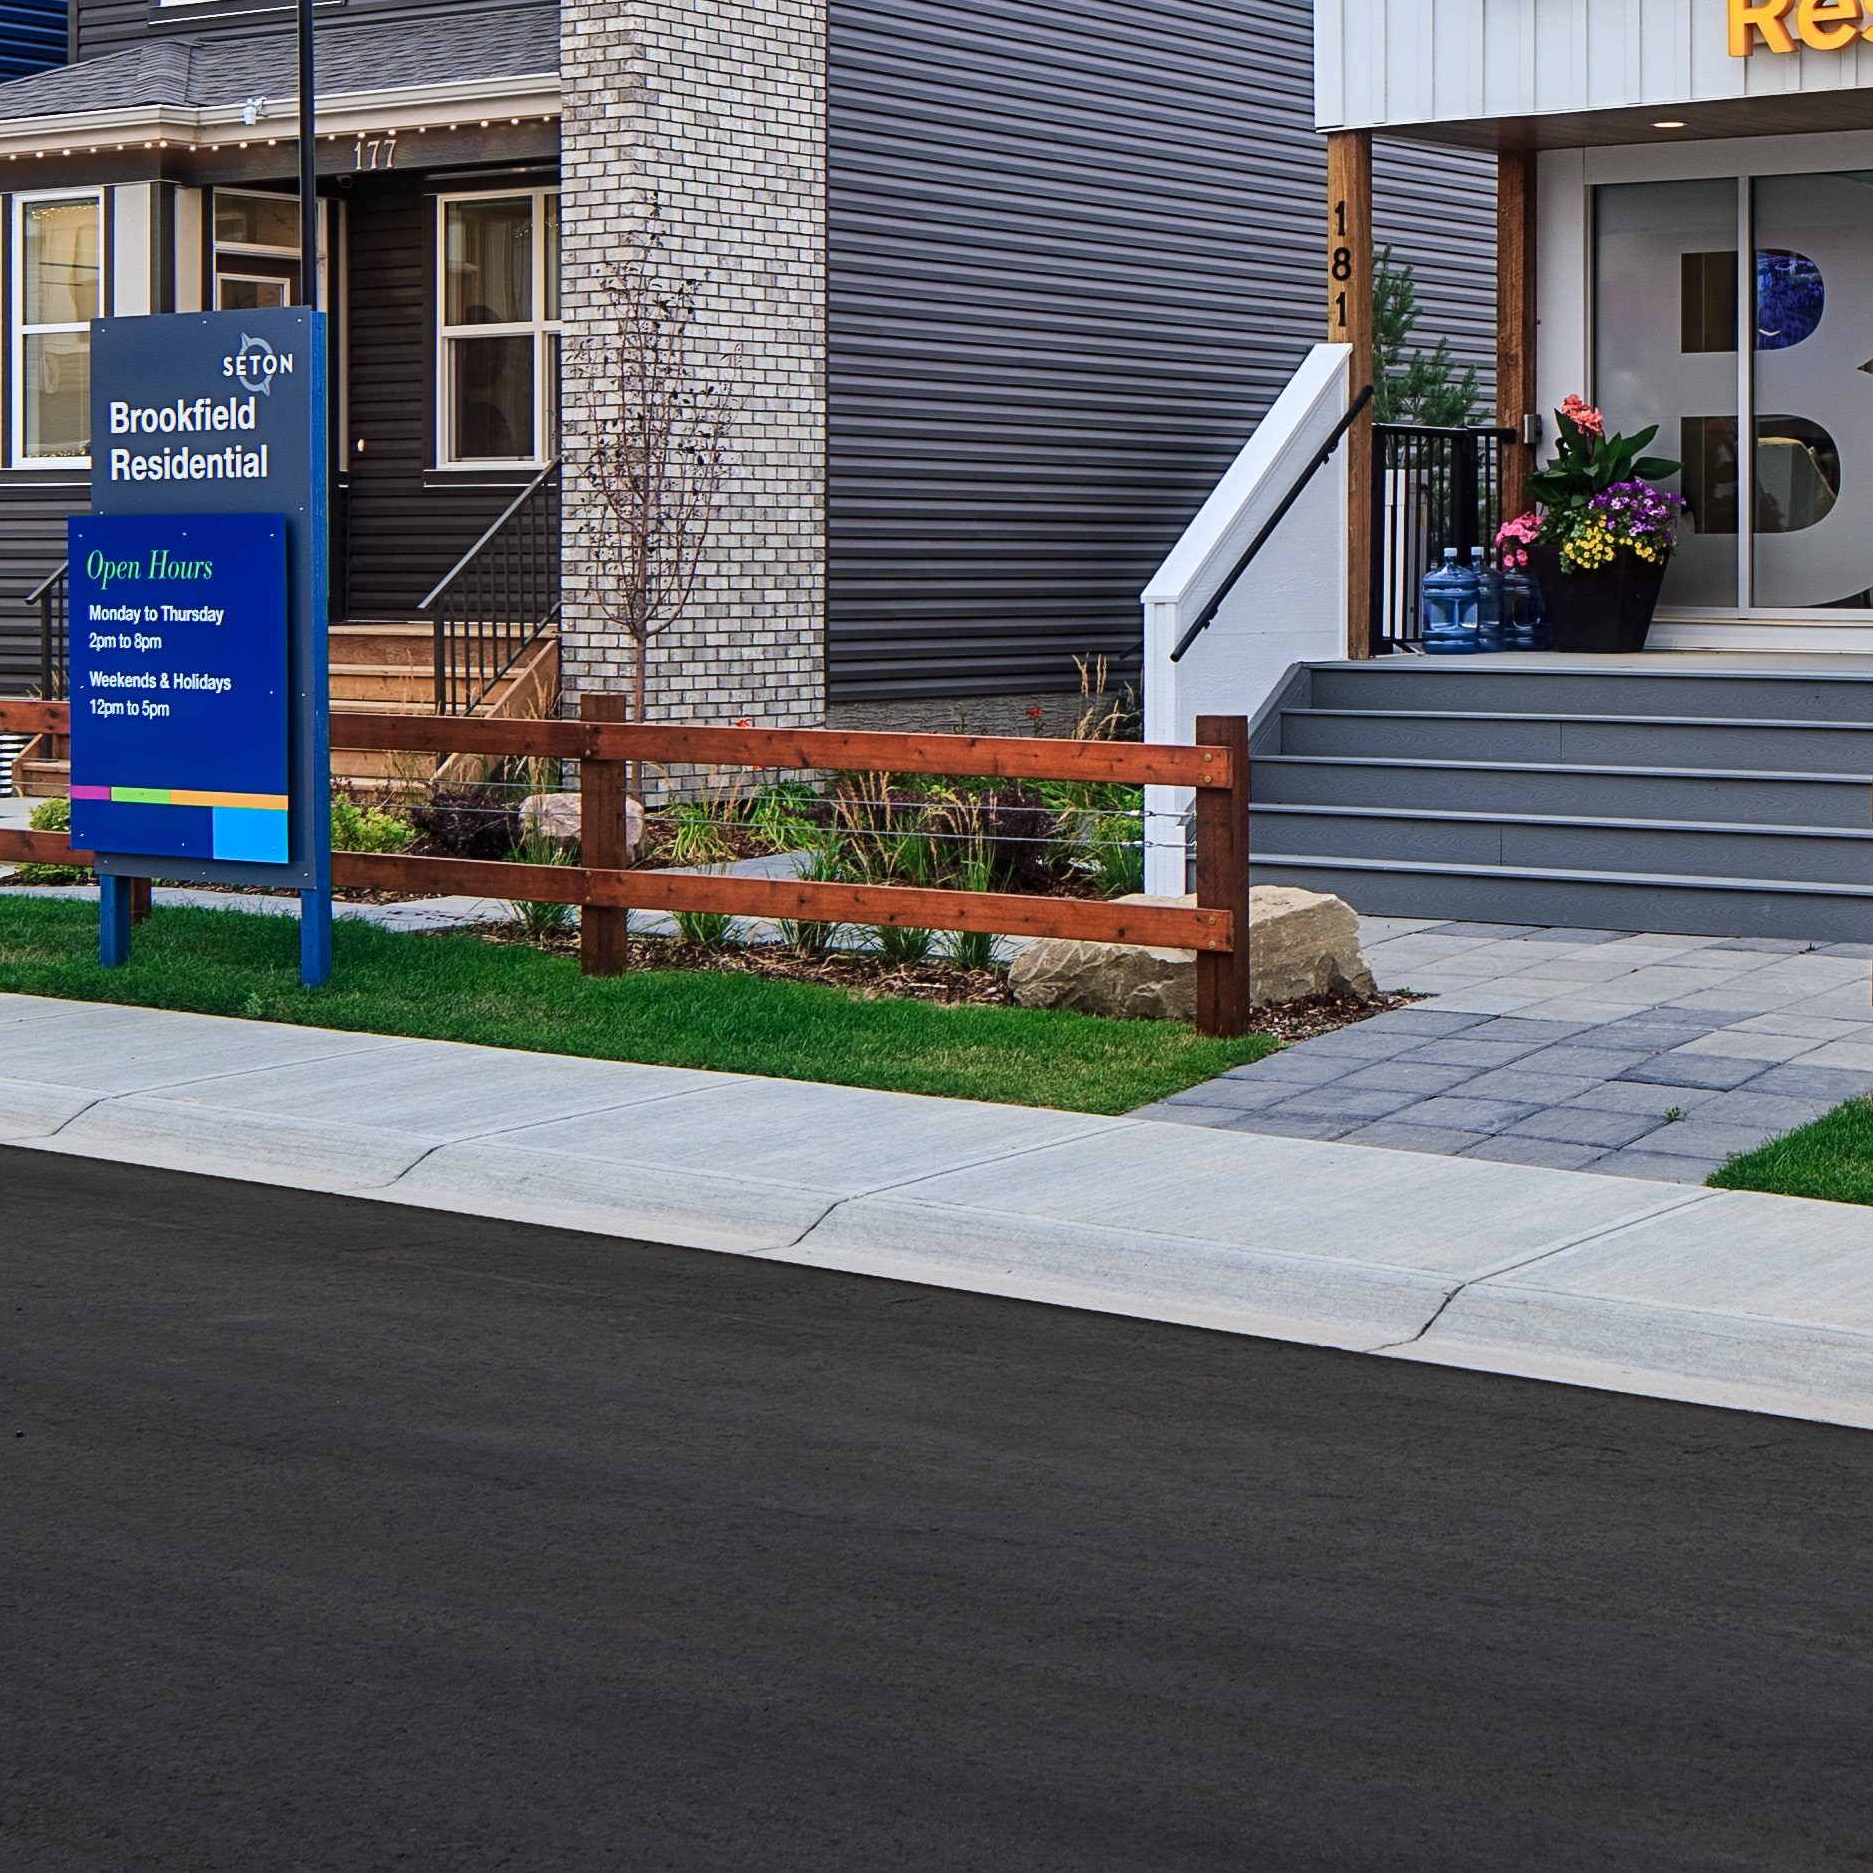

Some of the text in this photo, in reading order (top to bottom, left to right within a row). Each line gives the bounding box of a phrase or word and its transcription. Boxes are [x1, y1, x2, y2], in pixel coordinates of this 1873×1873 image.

[354, 139, 397, 170] 177
[1332, 200, 1352, 327] 181
[222, 353, 293, 376] SETON
[109, 396, 256, 434] Brookfield
[110, 444, 268, 481] Residential
[87, 549, 213, 590] Open Hours
[88, 605, 224, 626] Monday to Thursday
[89, 632, 162, 652] 2pm to 8pm
[89, 671, 232, 694] Weekends & Holidays
[90, 699, 170, 720] 12pm to 5pm
